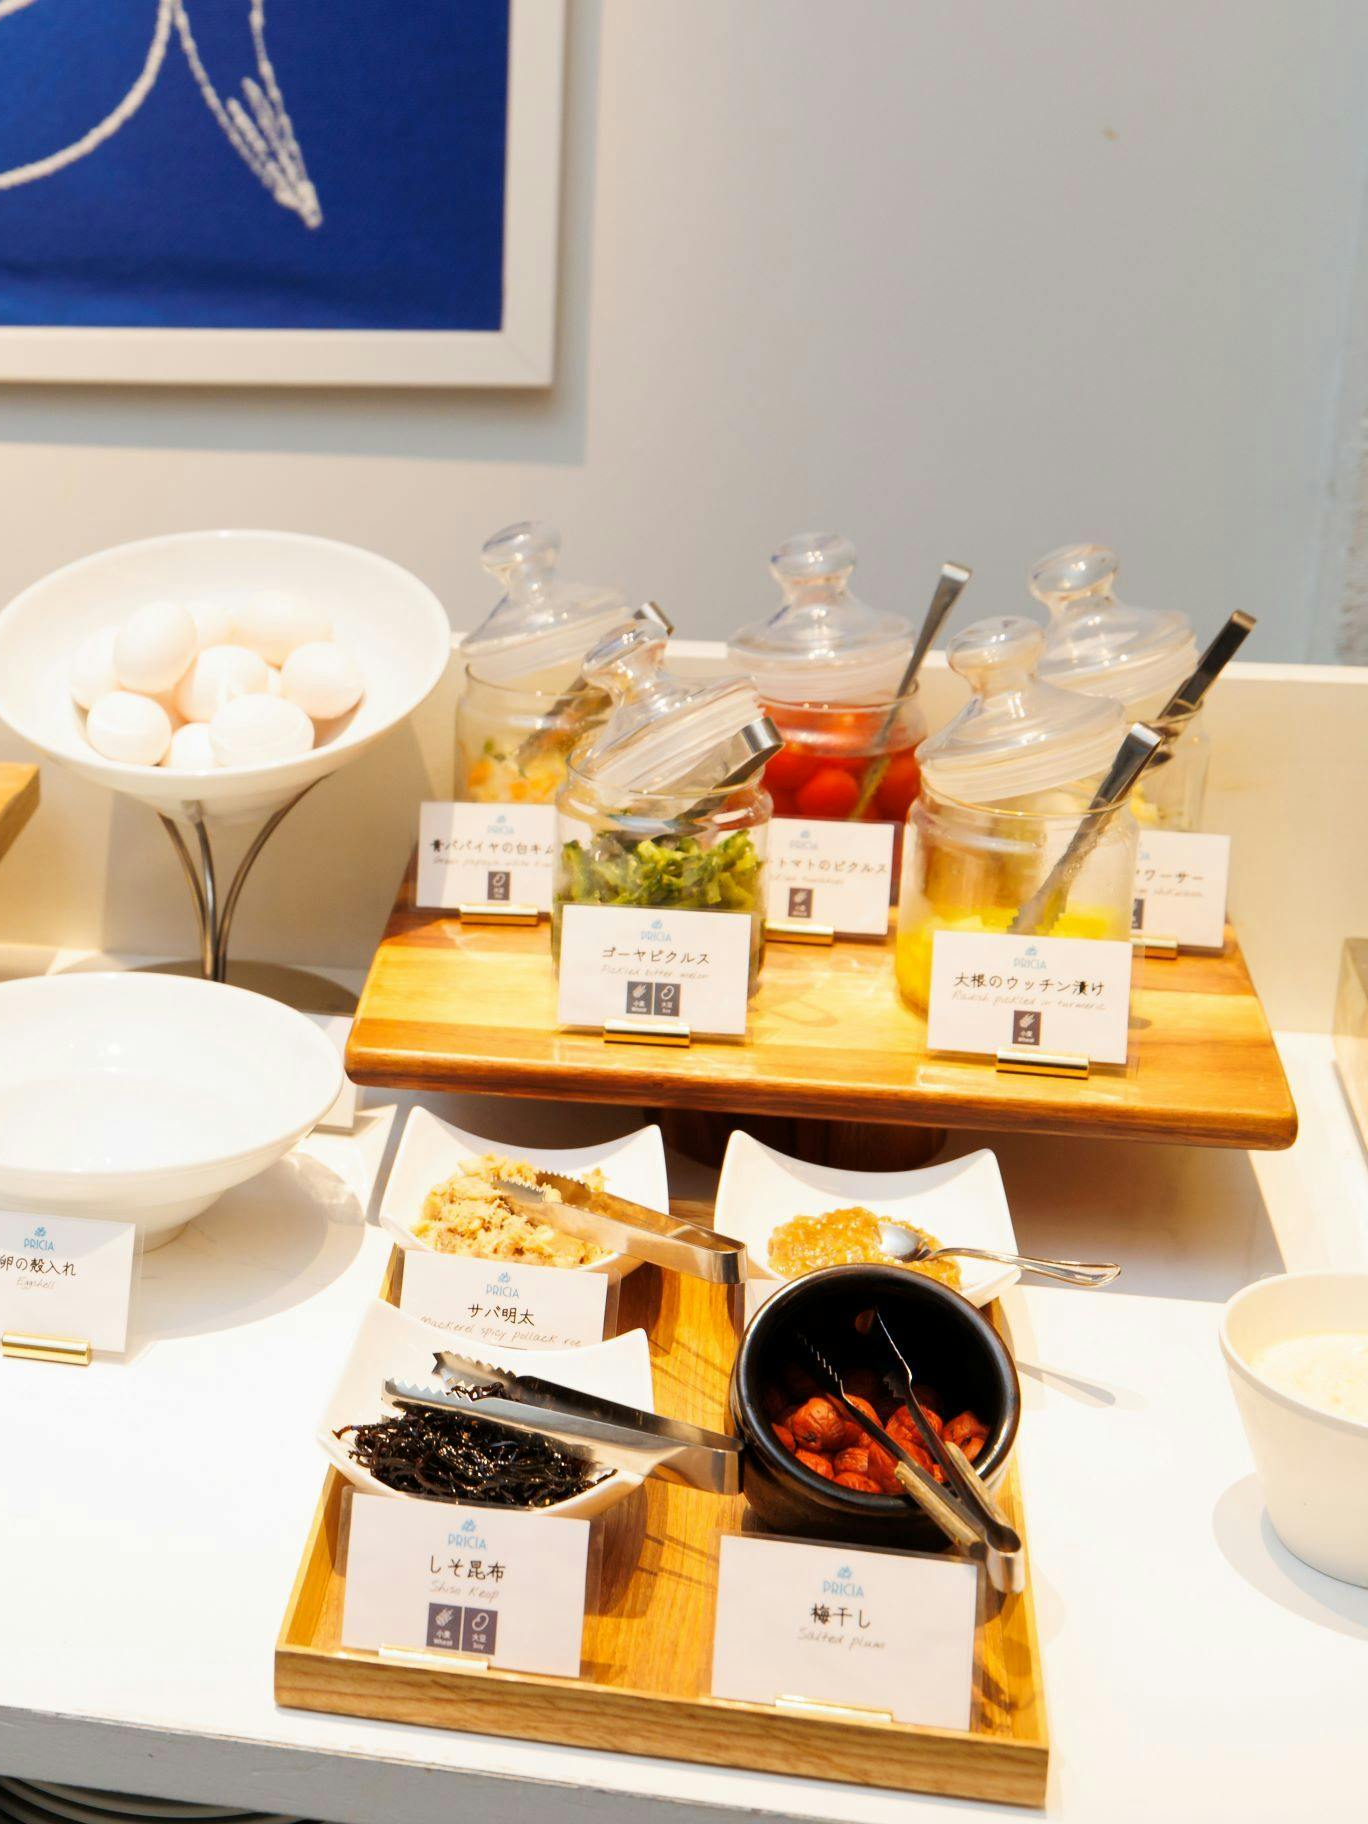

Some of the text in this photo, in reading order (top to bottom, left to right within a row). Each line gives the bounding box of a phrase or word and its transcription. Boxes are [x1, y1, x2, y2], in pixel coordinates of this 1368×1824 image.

[602, 947, 710, 965] ゴーヤピクルス
[1014, 957, 1048, 970] PRICIA
[954, 972, 1105, 996] 大根のウッチン漬け
[24, 1238, 55, 1251] PRICIA
[0, 1254, 77, 1277] 卵の殻入れ
[486, 1283, 520, 1299] PRICIA
[467, 1303, 535, 1326] サバ明太
[448, 1534, 487, 1549] PRICIA
[431, 1554, 505, 1582] しそ昆布
[823, 1580, 865, 1598] PRICIA
[811, 1603, 871, 1629] 梅干し
